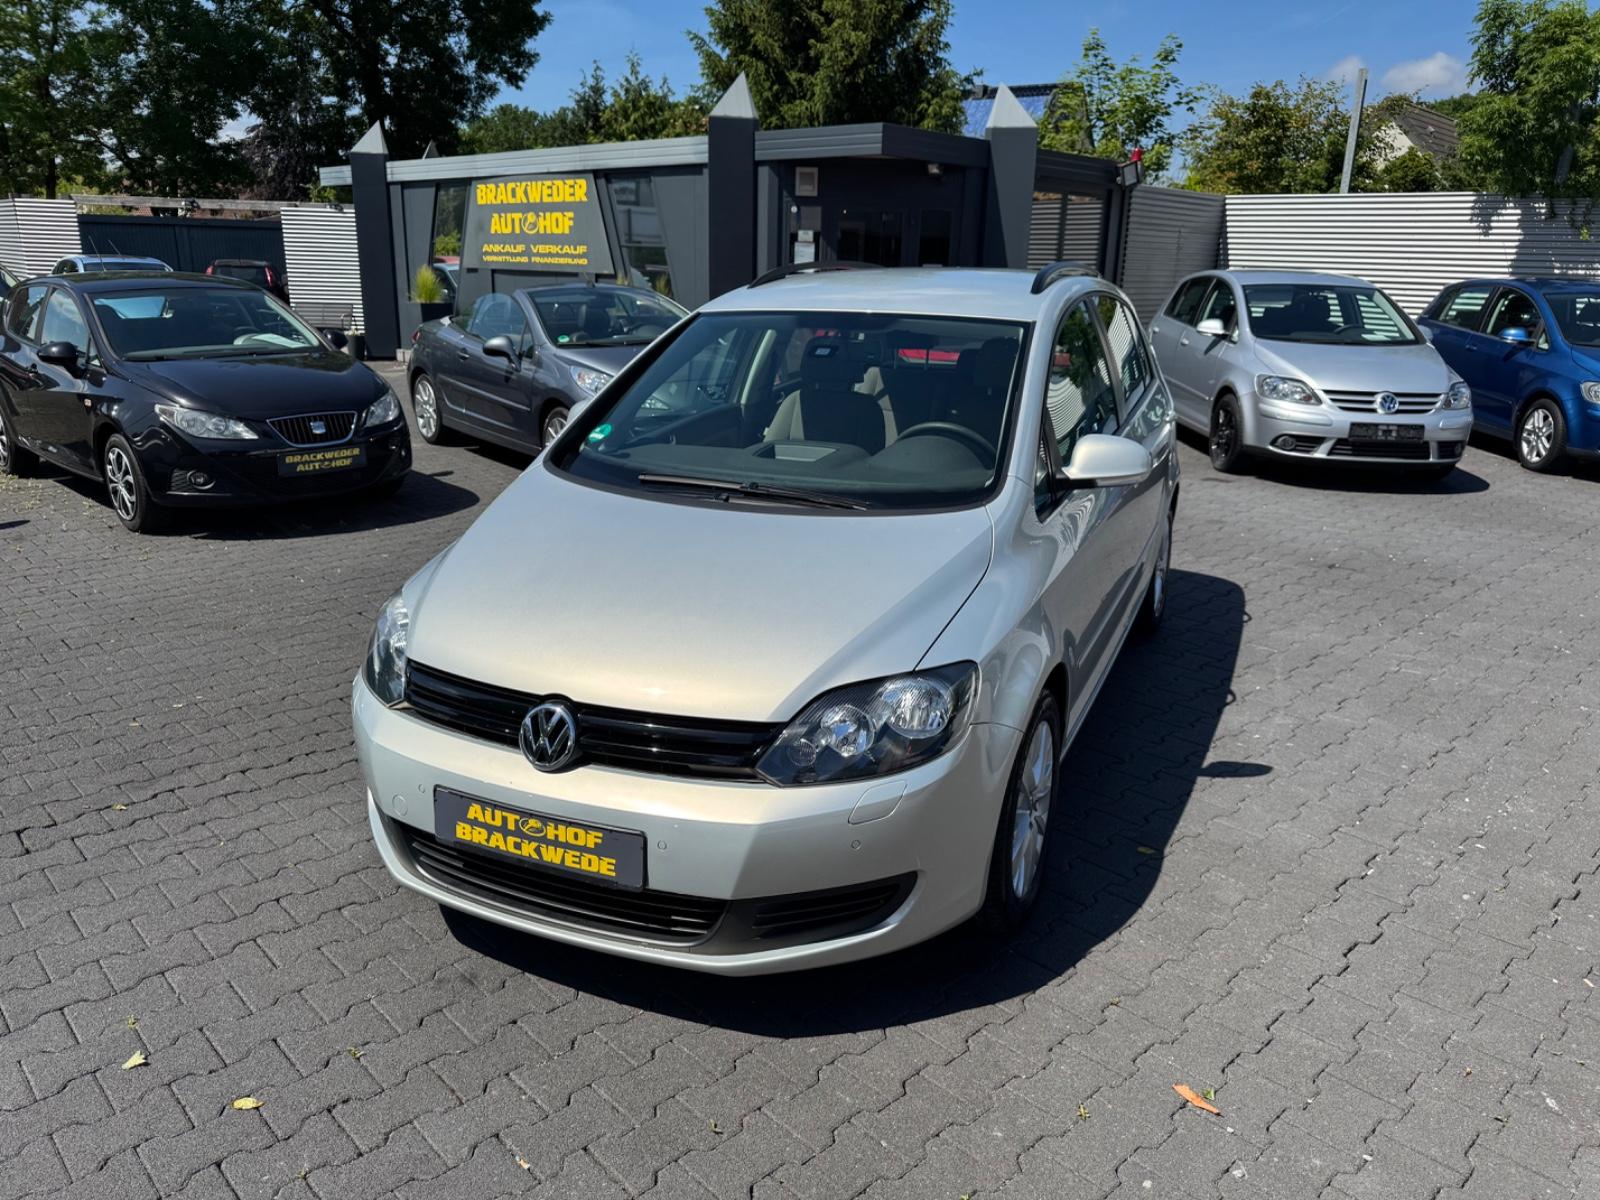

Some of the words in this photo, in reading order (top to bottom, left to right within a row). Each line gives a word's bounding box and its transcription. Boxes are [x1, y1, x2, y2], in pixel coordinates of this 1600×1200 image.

[476, 178, 588, 205] BRACKWEDER
[490, 211, 575, 234] AUTOHOF
[482, 244, 526, 253] ANKAUF
[531, 245, 588, 255] VERKAUF
[285, 447, 360, 463] BRACKWEDER
[466, 803, 603, 849] AUTOHOF
[455, 821, 616, 877] BRACKWEDE
